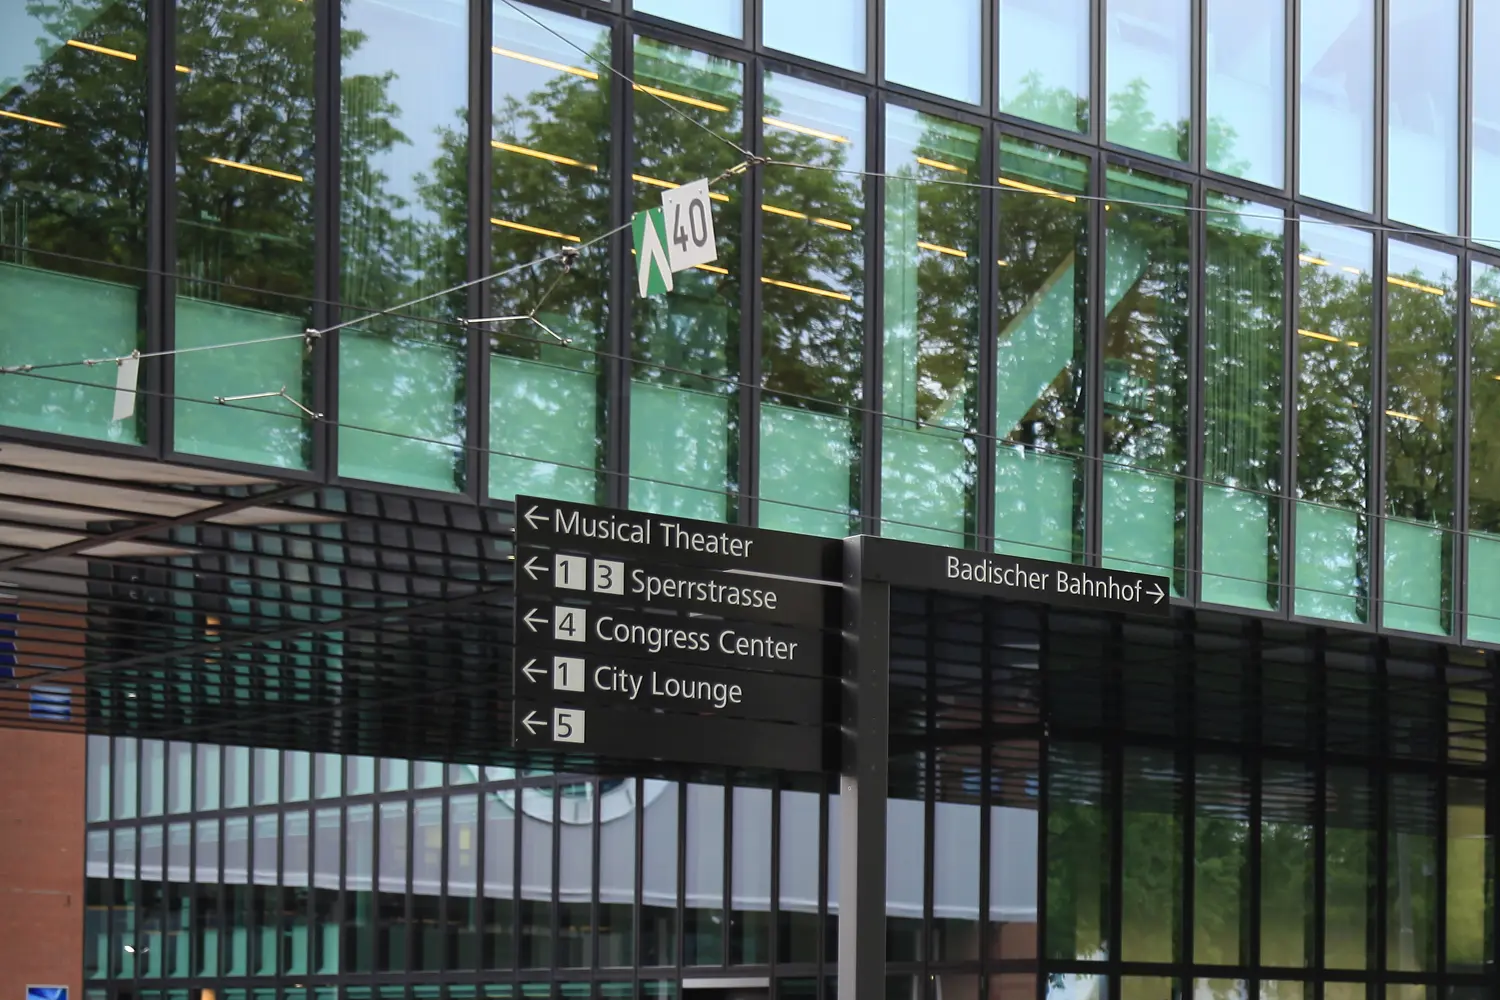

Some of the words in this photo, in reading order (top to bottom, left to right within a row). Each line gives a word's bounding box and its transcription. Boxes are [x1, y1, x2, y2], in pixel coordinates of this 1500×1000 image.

[673, 198, 708, 252] 40
[554, 508, 651, 545] Musical
[661, 523, 753, 558] Theater
[559, 561, 571, 585] 1
[597, 566, 613, 589] 3
[631, 569, 778, 610] Sperrstrasse
[946, 555, 1049, 590] Badischer
[1055, 570, 1142, 603] Bahnhof
[558, 613, 576, 637] 4
[596, 616, 710, 654] Congress
[719, 630, 798, 661] Center
[558, 662, 570, 687] 1
[594, 665, 643, 700] City
[651, 672, 742, 709] Lounge
[558, 713, 572, 738] 5
